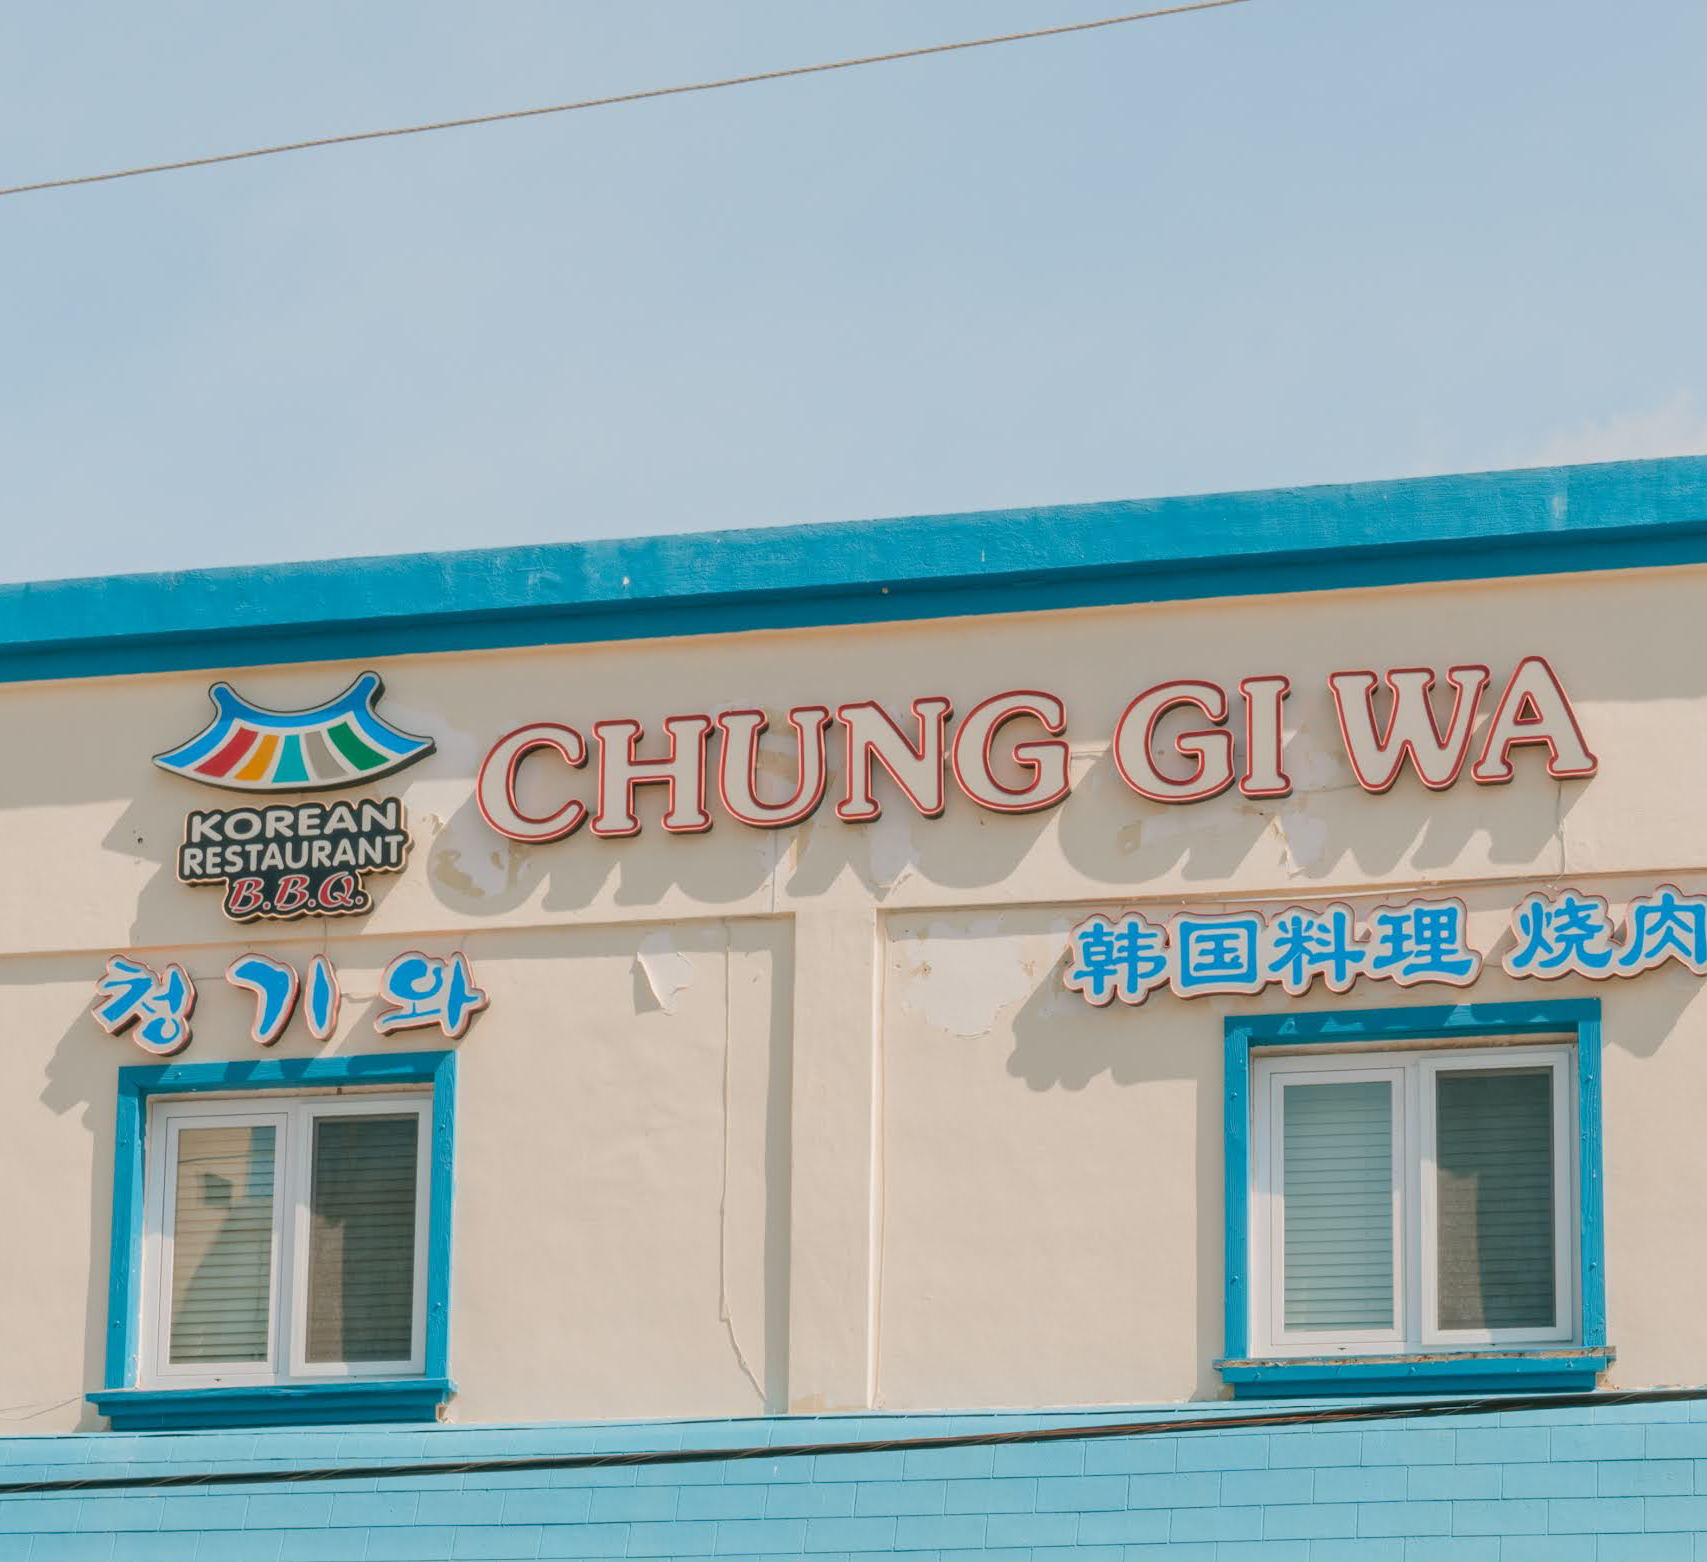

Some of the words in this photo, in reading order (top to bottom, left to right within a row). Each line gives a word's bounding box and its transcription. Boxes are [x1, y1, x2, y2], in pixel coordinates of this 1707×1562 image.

[476, 689, 1073, 844] CHUNG
[1113, 675, 1291, 803] GI
[1329, 656, 1599, 794] WA
[183, 835, 404, 876] RESTAURANT
[191, 801, 398, 842] KOREAN
[230, 872, 364, 914] B.B.Q.
[1068, 900, 1479, 1001] 韩国料理
[94, 952, 488, 1054] 청기와
